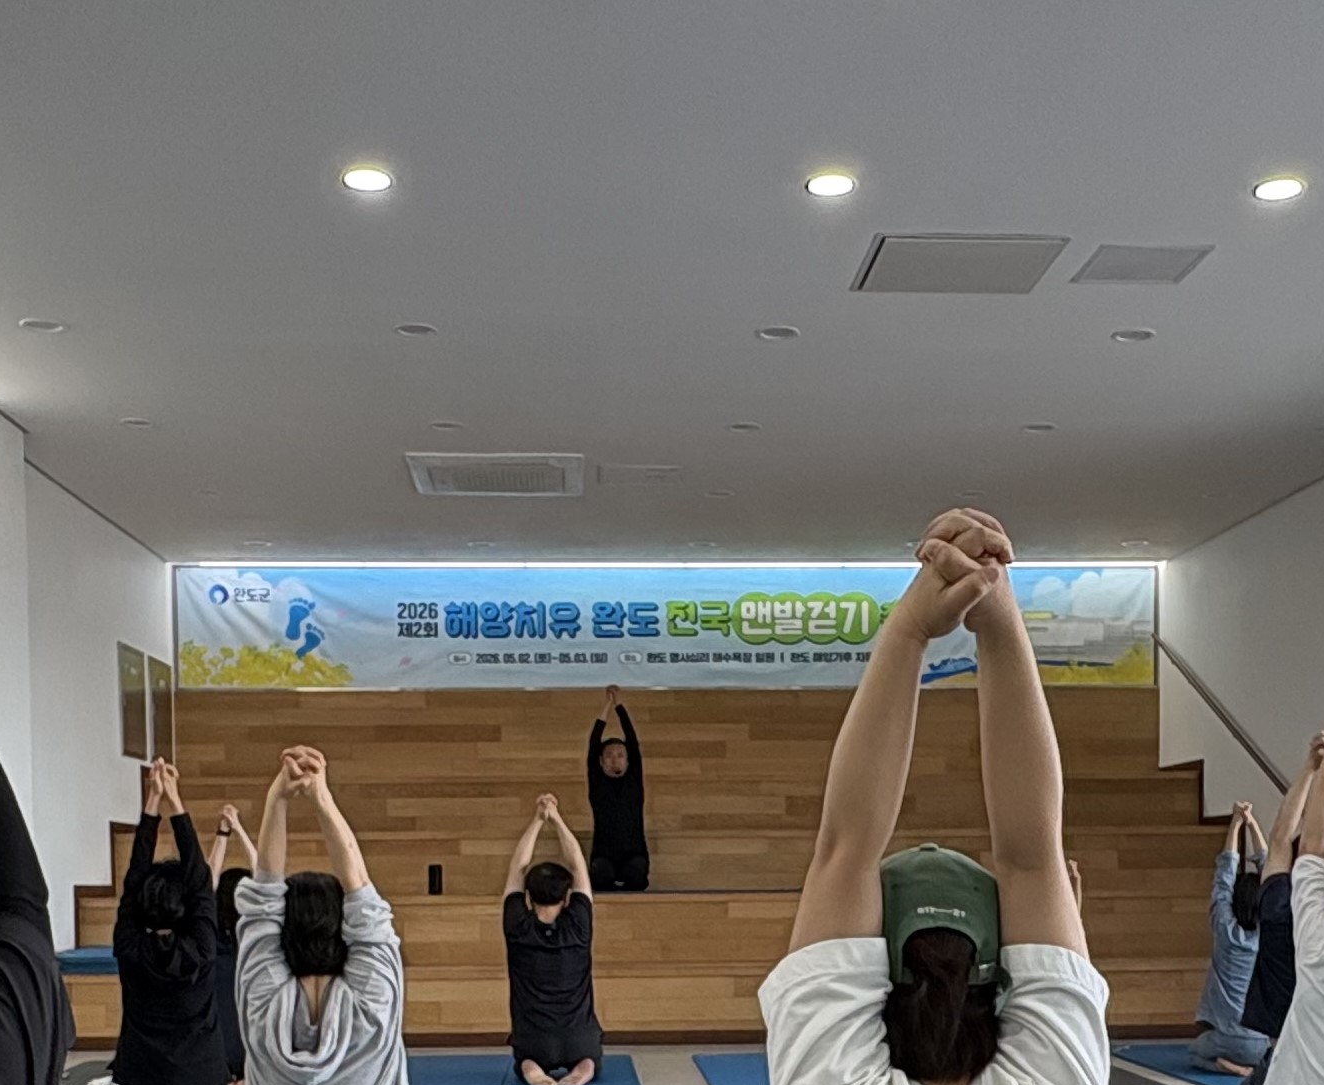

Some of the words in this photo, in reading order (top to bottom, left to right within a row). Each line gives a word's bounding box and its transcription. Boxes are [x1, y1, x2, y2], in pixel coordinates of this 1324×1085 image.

[233, 587, 271, 602] 완도군
[397, 602, 439, 620] 2026
[443, 600, 582, 639] 해양치유
[592, 601, 660, 638] 완도
[665, 601, 731, 637] 전국
[740, 600, 870, 636] 맨발걷기
[397, 622, 439, 638] 제2회
